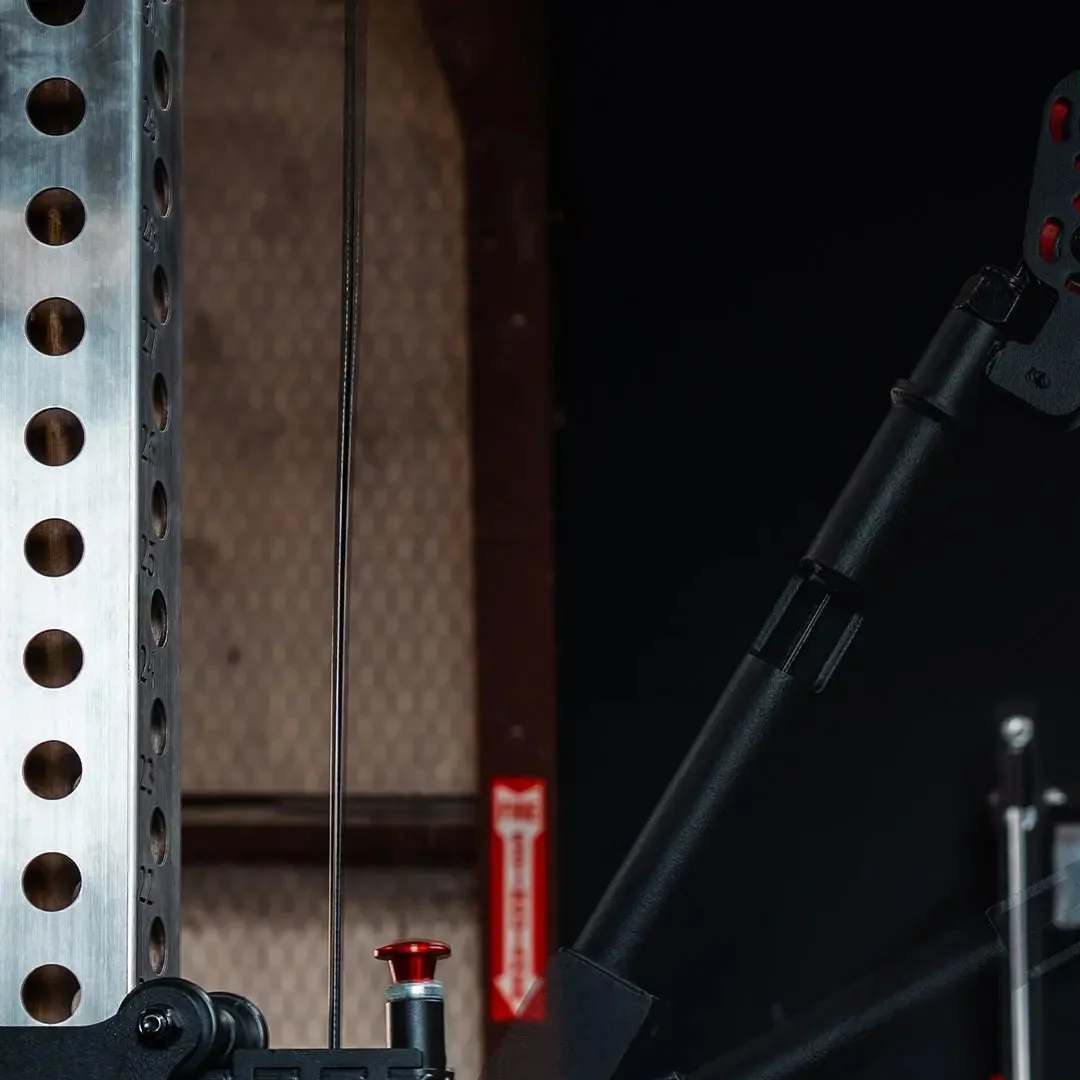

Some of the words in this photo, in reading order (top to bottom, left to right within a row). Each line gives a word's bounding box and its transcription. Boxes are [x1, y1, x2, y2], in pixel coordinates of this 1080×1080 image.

[140, 533, 156, 577] 25
[139, 644, 156, 688] 24
[139, 754, 155, 795] 23
[138, 864, 154, 905] 22
